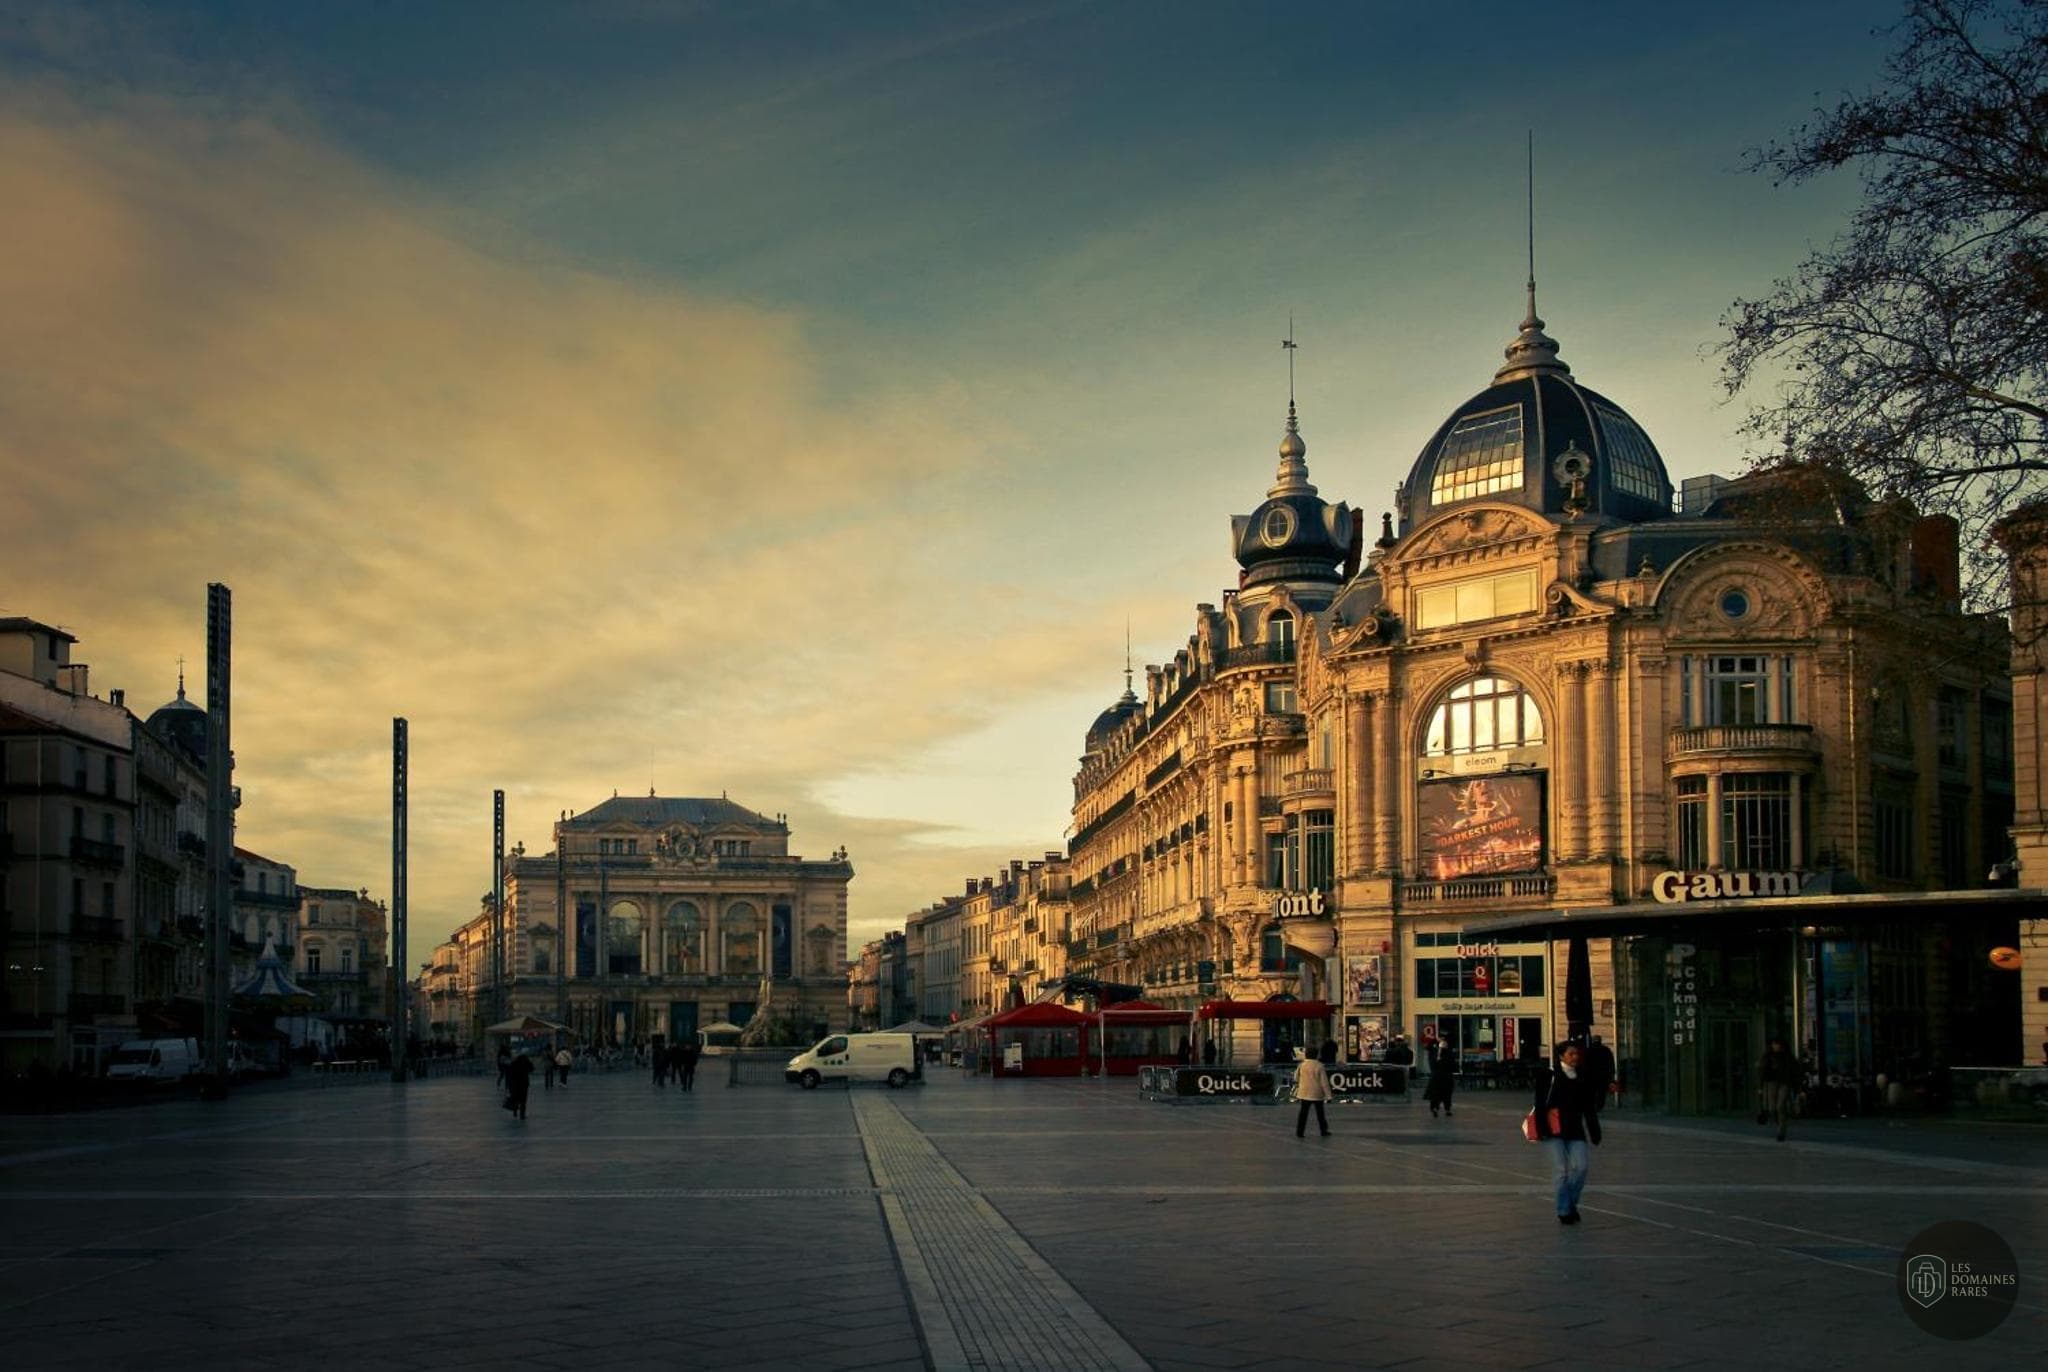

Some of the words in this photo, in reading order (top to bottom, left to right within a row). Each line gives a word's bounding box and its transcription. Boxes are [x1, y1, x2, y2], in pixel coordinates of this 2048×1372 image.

[1456, 943, 1498, 959] Quick
[1198, 1075, 1252, 1092] Quick
[1330, 1073, 1383, 1091] Quick
